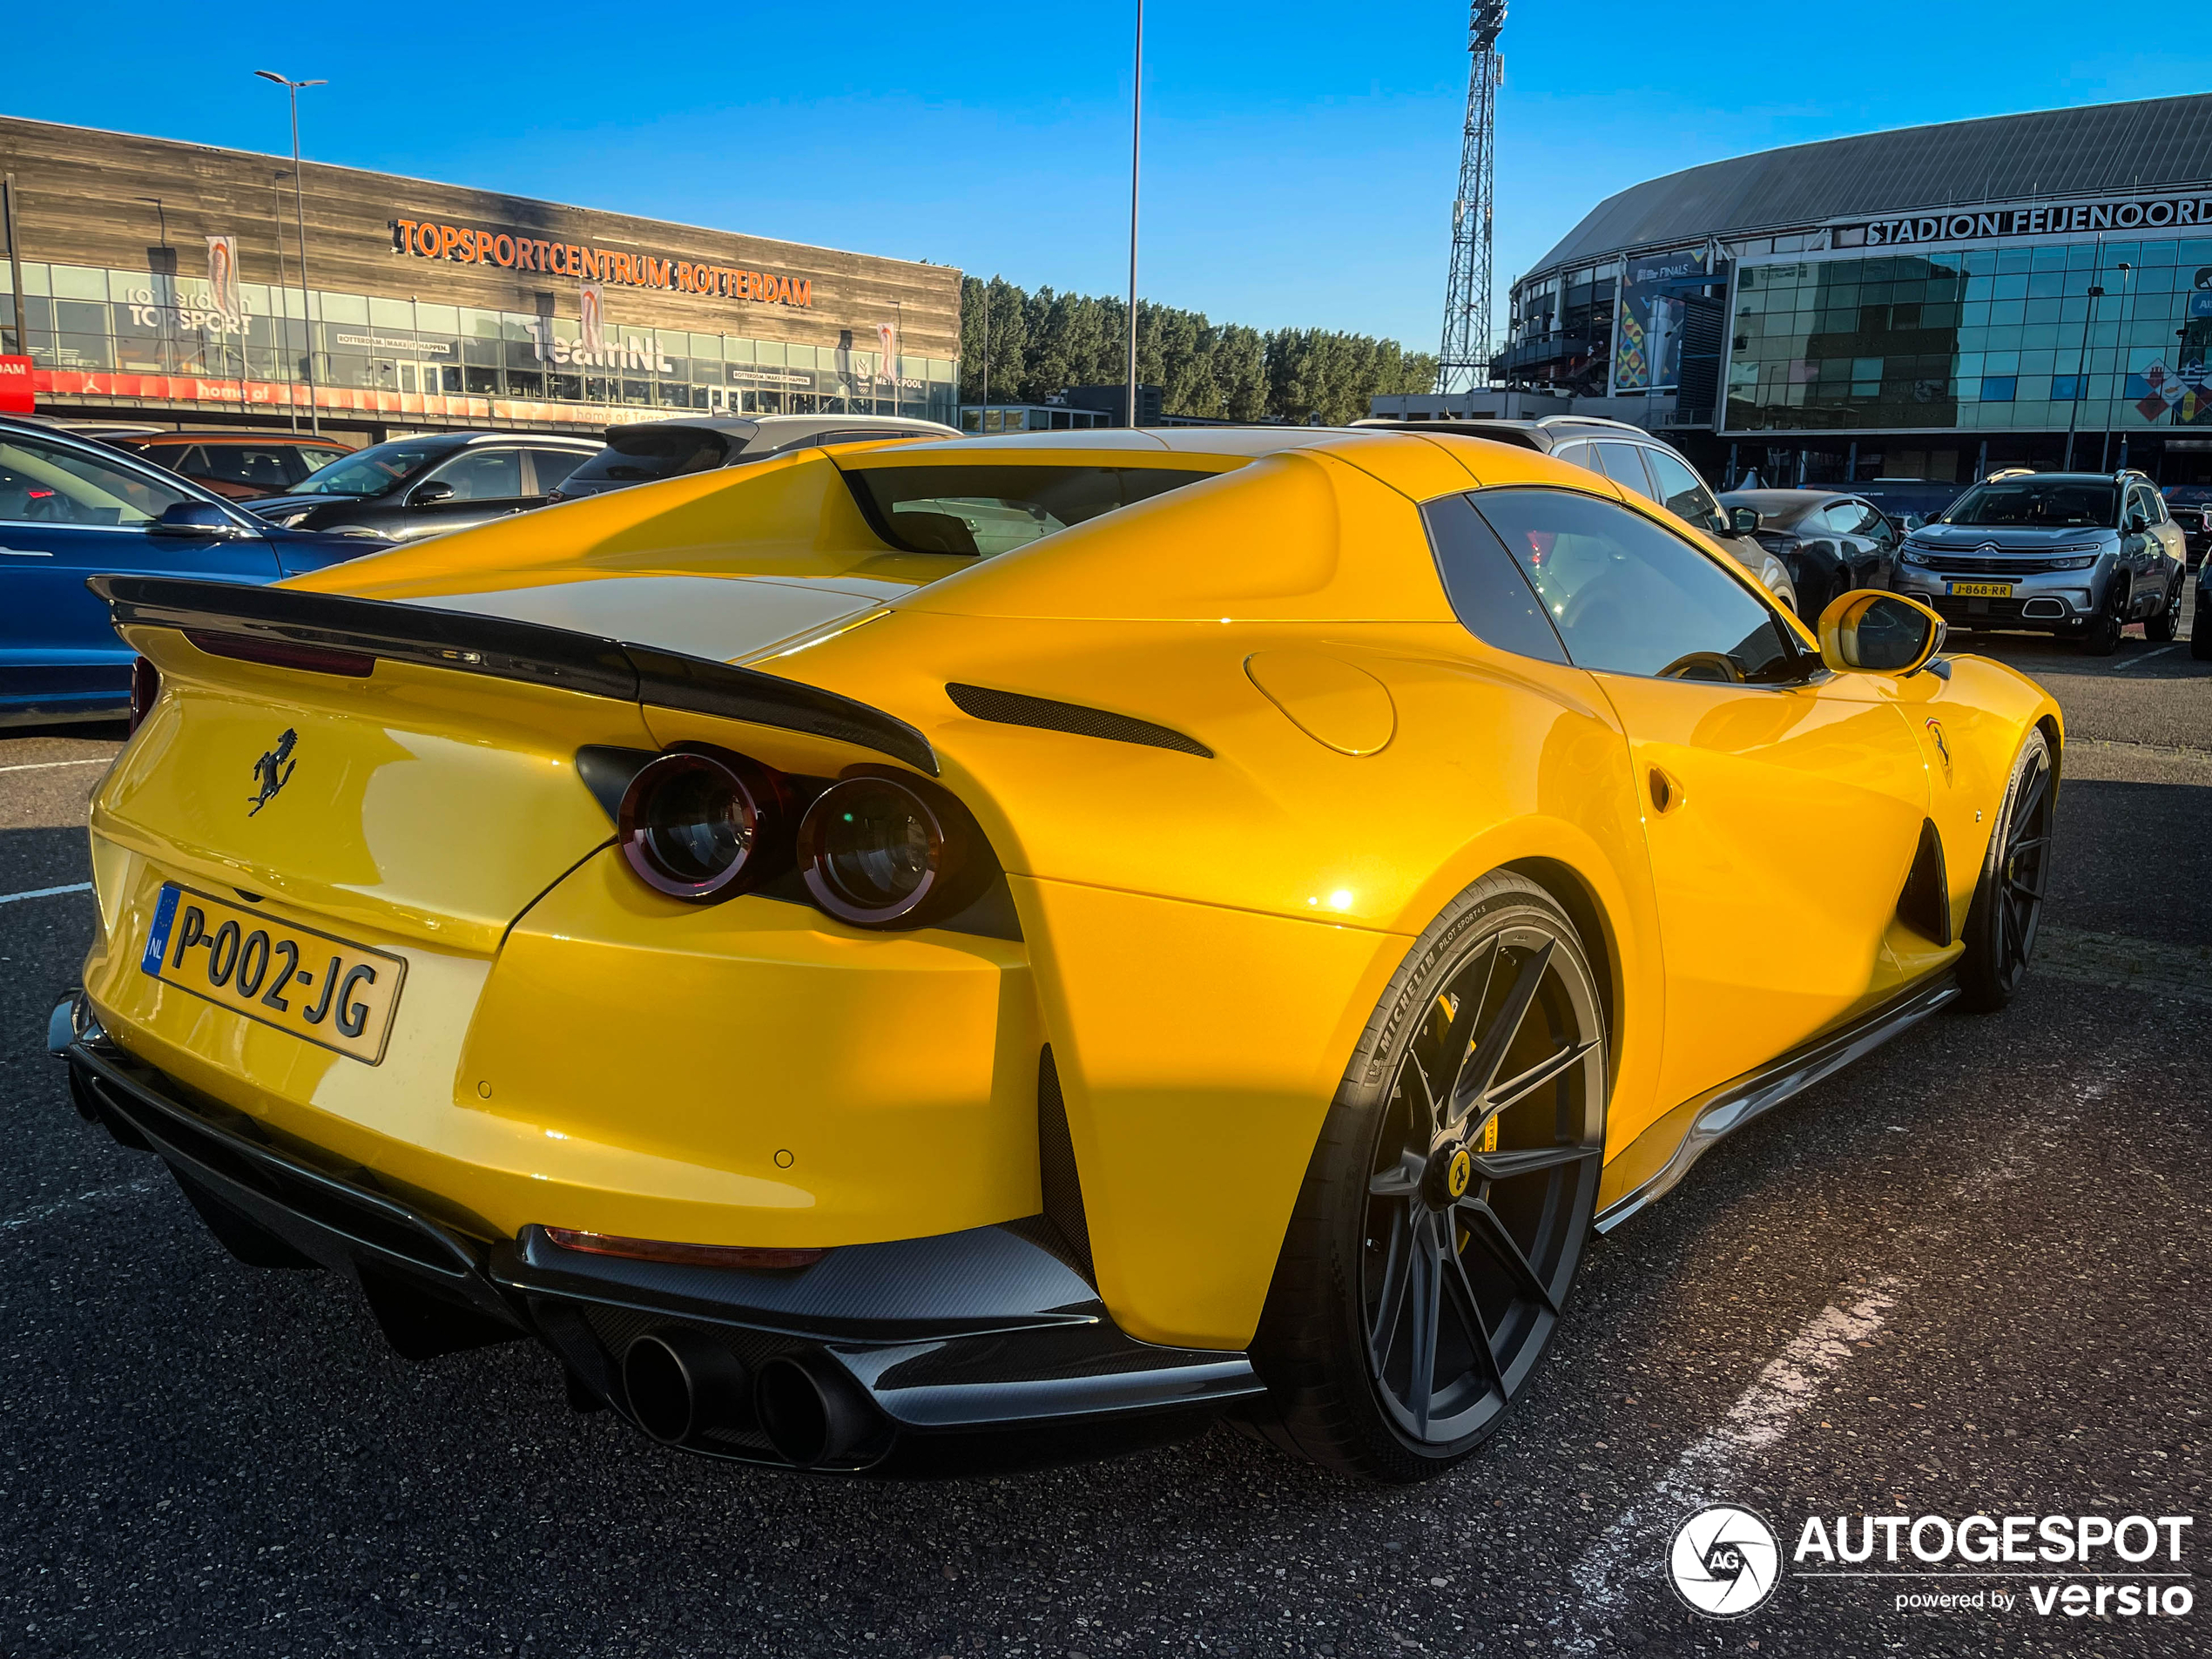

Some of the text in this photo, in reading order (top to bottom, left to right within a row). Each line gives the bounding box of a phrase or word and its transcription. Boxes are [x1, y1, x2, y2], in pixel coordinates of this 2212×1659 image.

[1865, 212, 2001, 246] STADION
[397, 219, 813, 307] TOPSPORTCENTRUM ROTTERDAM
[253, 385, 270, 401] of
[576, 406, 610, 421] home
[616, 411, 630, 422] of
[1955, 584, 2007, 596] J-868-RR
[149, 937, 162, 960] NL
[172, 906, 376, 1038] P-002-JG
[1379, 950, 1437, 1055] MICHELIN
[1439, 928, 1457, 952] PILOT
